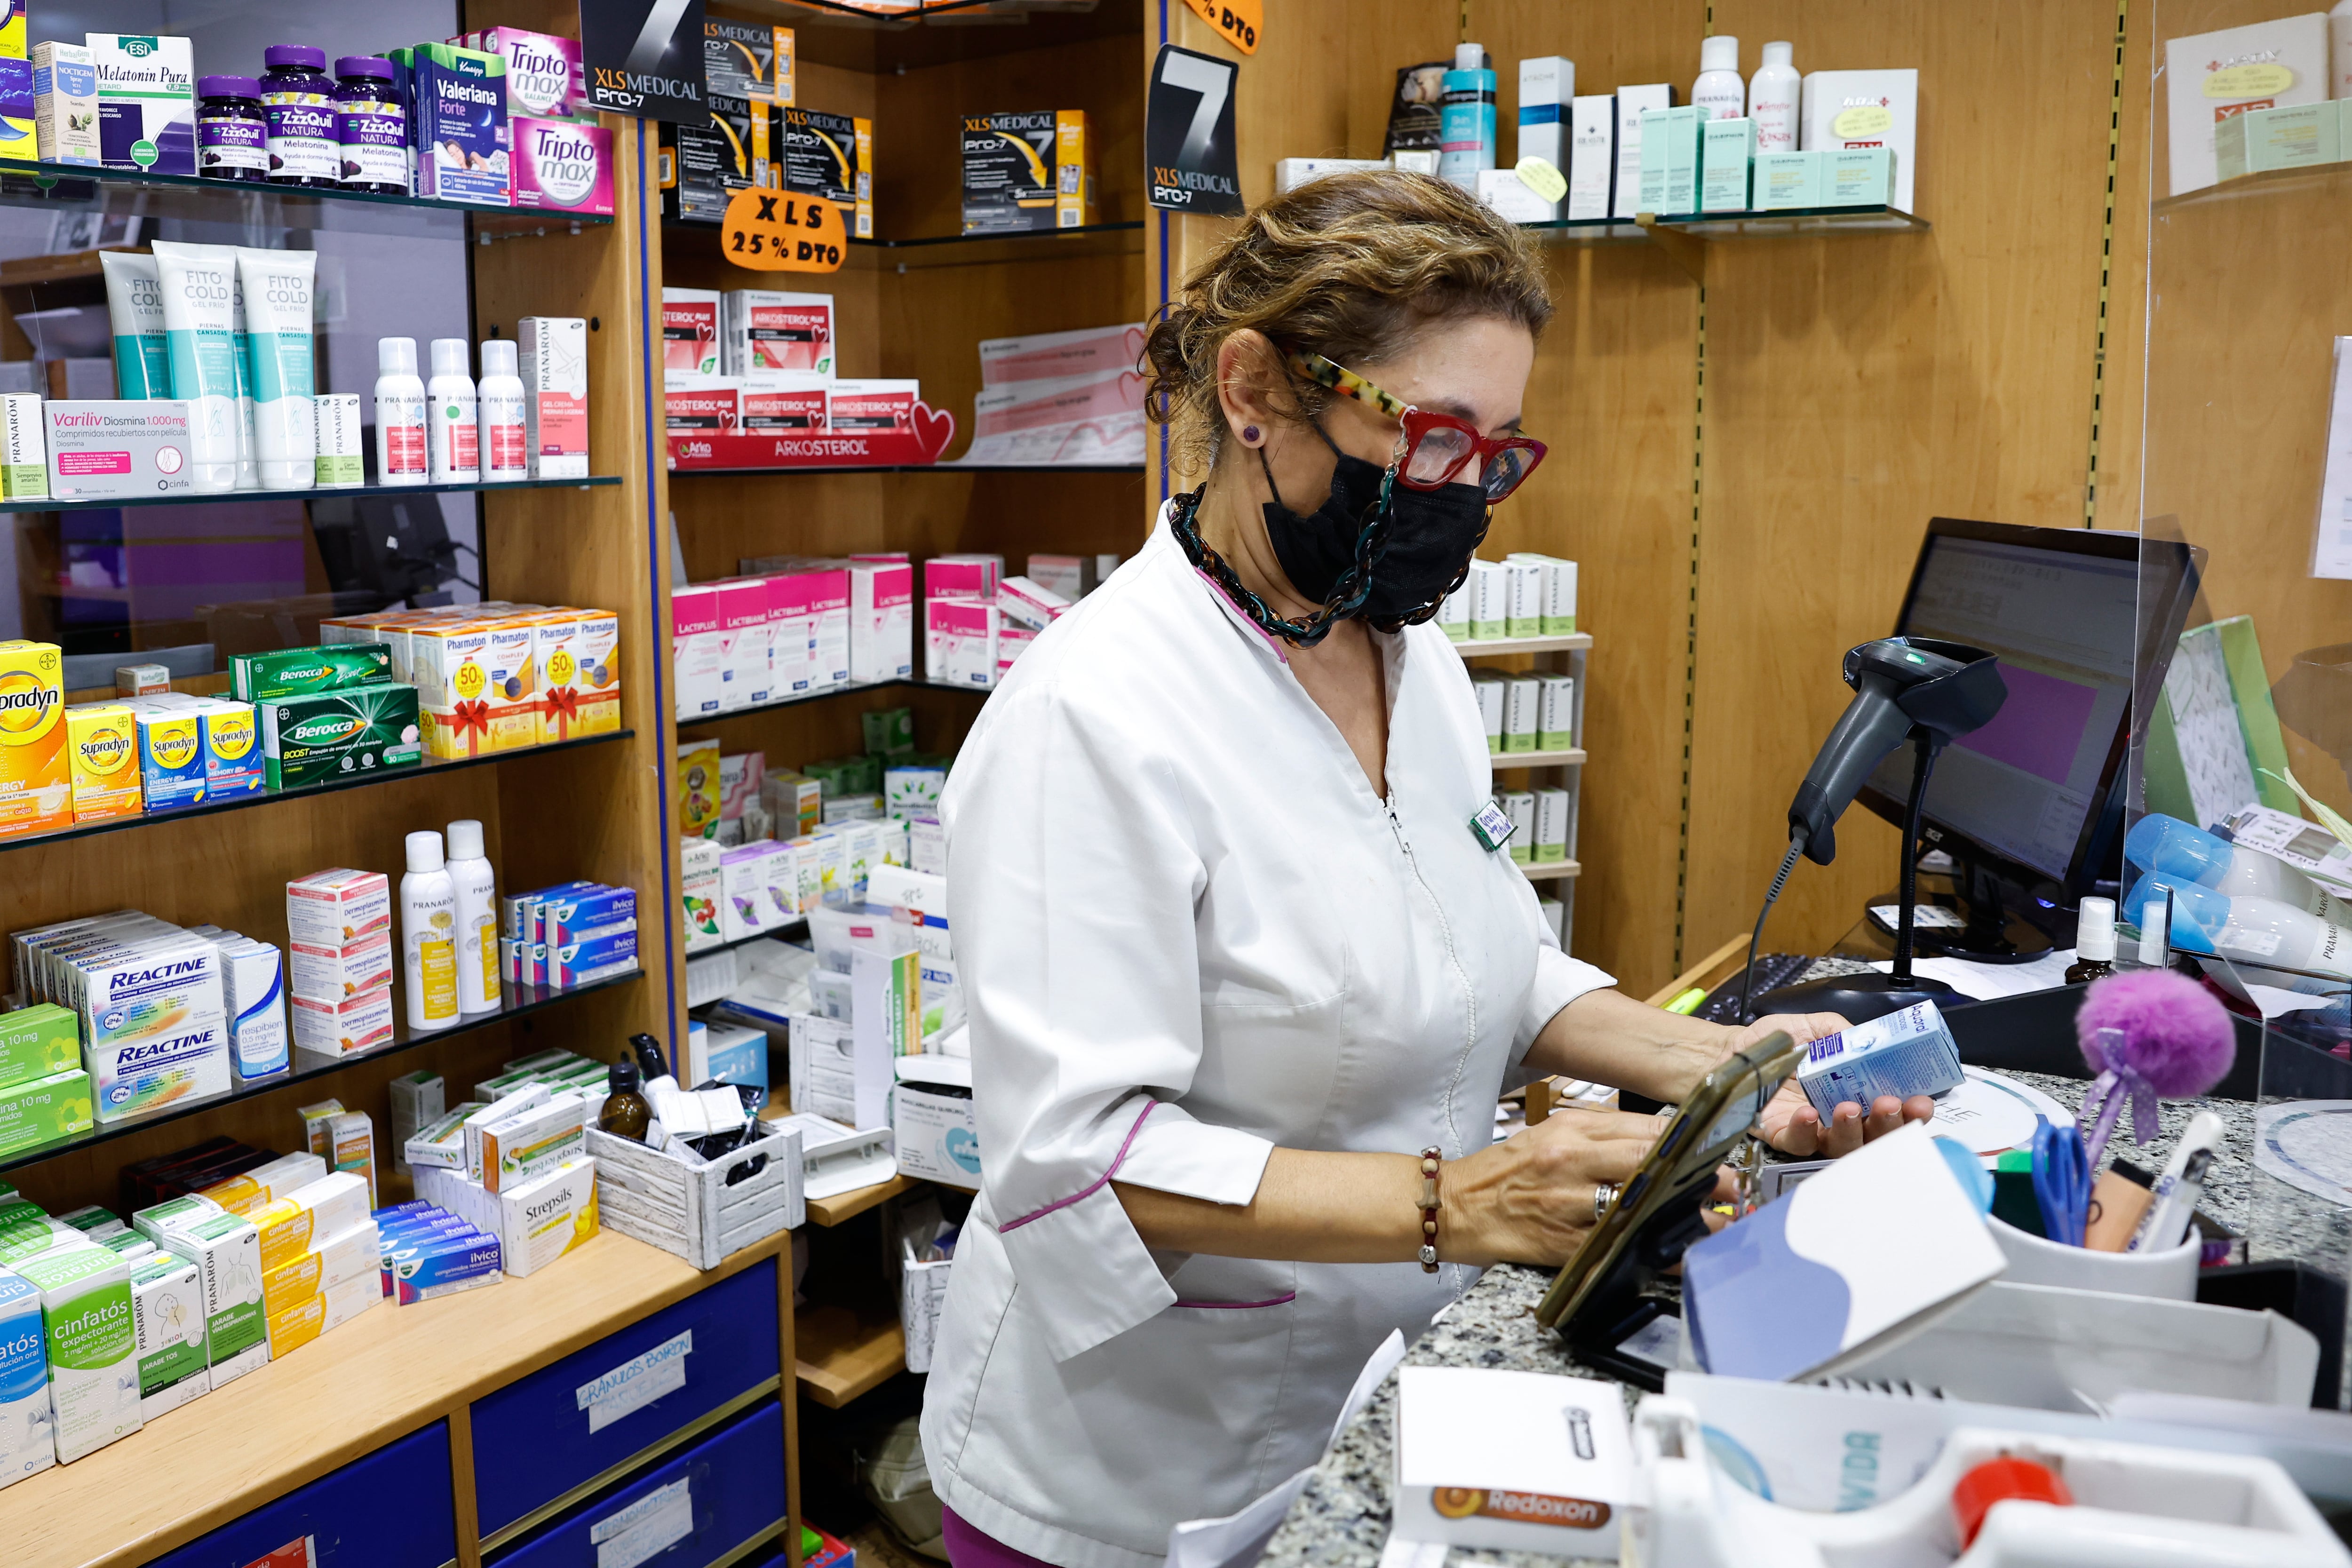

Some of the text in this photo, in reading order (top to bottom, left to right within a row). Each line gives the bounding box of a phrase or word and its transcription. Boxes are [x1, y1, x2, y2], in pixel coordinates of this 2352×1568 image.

[705, 23, 773, 45] LSMEDICAL
[1222, 7, 1255, 47] DTO
[60, 49, 89, 58] HerbalGem
[129, 45, 149, 56] ESI
[510, 42, 566, 76] Tripto
[59, 66, 93, 78] NOCTIGEM
[97, 64, 188, 83] Melatonin Pura
[459, 61, 484, 78] Kneipp
[437, 78, 497, 106] Valeriana
[515, 73, 564, 96] max
[524, 92, 552, 103] BALANCE
[439, 99, 466, 116] Forte
[1160, 50, 1233, 168] 7
[282, 111, 333, 128] ZzzQuil
[221, 127, 259, 139] ZzzQuil
[282, 126, 324, 137] NATURA
[359, 119, 404, 137] ZzzQuil
[284, 140, 328, 150] Melatonina
[360, 134, 398, 145] NATURA
[536, 128, 594, 161] Tripto
[362, 147, 401, 158] Melatonina
[541, 160, 593, 182] max
[755, 194, 823, 229] XLS
[797, 241, 840, 265] DTO
[186, 271, 222, 285] FITO
[268, 276, 302, 289] FITO
[131, 294, 162, 307] COL
[184, 286, 228, 300] COLD
[267, 290, 308, 304] COLD
[755, 314, 810, 326] ARKOSTEROL
[747, 400, 806, 411] ARKOSTEROL
[831, 401, 893, 412] ARKOSTEROL
[53, 412, 186, 427] Variliv Diosmina 1.000 mg
[55, 430, 104, 439] Comprimidos
[106, 428, 145, 437] recubiertos
[161, 428, 187, 438] película
[689, 441, 712, 453] Arko
[775, 439, 869, 457] ARKOSTEROL
[169, 479, 189, 488] cinfa
[811, 597, 846, 611] LACTIBIANE
[768, 605, 807, 619] LACTIBIANE
[581, 621, 616, 635] Pharmaton
[678, 620, 717, 635] LACTIPLUS
[727, 613, 767, 628] LACTIBIANE
[492, 630, 529, 645] Pharmaton
[540, 626, 576, 640] Pharmaton
[447, 635, 486, 651] Pharmaton
[497, 652, 524, 660] COMPLEX
[279, 667, 325, 681] Berocca
[458, 684, 483, 692] DESCUENTO
[0, 686, 58, 710] pradyn
[213, 729, 252, 744] Supradyn
[294, 719, 355, 740] Berocca
[80, 737, 129, 755] Supradyn
[153, 736, 195, 752] Supradyn
[283, 748, 310, 760] BOOST
[208, 767, 234, 777] MEMORY
[149, 777, 174, 786] ENERGY
[78, 812, 87, 821] 30
[344, 897, 388, 916] Dermoplasmine
[612, 898, 635, 910] ilvico
[614, 937, 636, 950] ilvico
[344, 952, 390, 973] Dermoplasmine
[109, 956, 208, 990] REACTINE
[341, 1007, 390, 1028] Dermoplasmine
[1911, 1004, 1929, 1034] Aquoral
[242, 1020, 283, 1036] respibien
[8, 1032, 38, 1046] 10 mg
[255, 1031, 277, 1041] mg/ml
[117, 1029, 215, 1065] REACTINE
[62, 1058, 78, 1067] cinfa
[1821, 1074, 1834, 1094] ESTEVE
[21, 1093, 51, 1108] 10 mg
[75, 1119, 91, 1127] cinfa
[225, 1189, 265, 1213] cinfamucol
[525, 1187, 572, 1222] Strepsils
[414, 1207, 443, 1219] ilvico
[268, 1212, 307, 1237] cinfamucol
[430, 1216, 459, 1227] ilvico
[444, 1224, 473, 1235] ilvico
[464, 1233, 494, 1245] ilvico
[470, 1250, 499, 1264] ilvico
[275, 1255, 316, 1281] cinfamucol
[435, 1264, 469, 1277] comprimidos
[280, 1297, 320, 1324] cinfamucol
[54, 1299, 128, 1341] cinfatós
[211, 1312, 235, 1329] JARABE
[212, 1309, 257, 1335] VÍAS RESPIRATORIAS
[61, 1316, 129, 1350] expectorante
[161, 1333, 183, 1348] JUNIOR
[0, 1334, 39, 1360] atós
[70, 1342, 93, 1357] mg/ml
[99, 1336, 107, 1345] 20
[90, 1334, 130, 1356] solución oral
[238, 1338, 265, 1355] AROMAFORCE
[25, 1349, 39, 1361] oral
[141, 1351, 178, 1372] JARABE TOS
[177, 1366, 206, 1384] AROMAFORCE
[578, 1334, 690, 1408] GRÁNULOS BOIRON
[123, 1418, 139, 1431] cinfa
[34, 1454, 53, 1466] cinfa
[1488, 1489, 1598, 1522] Redoxon
